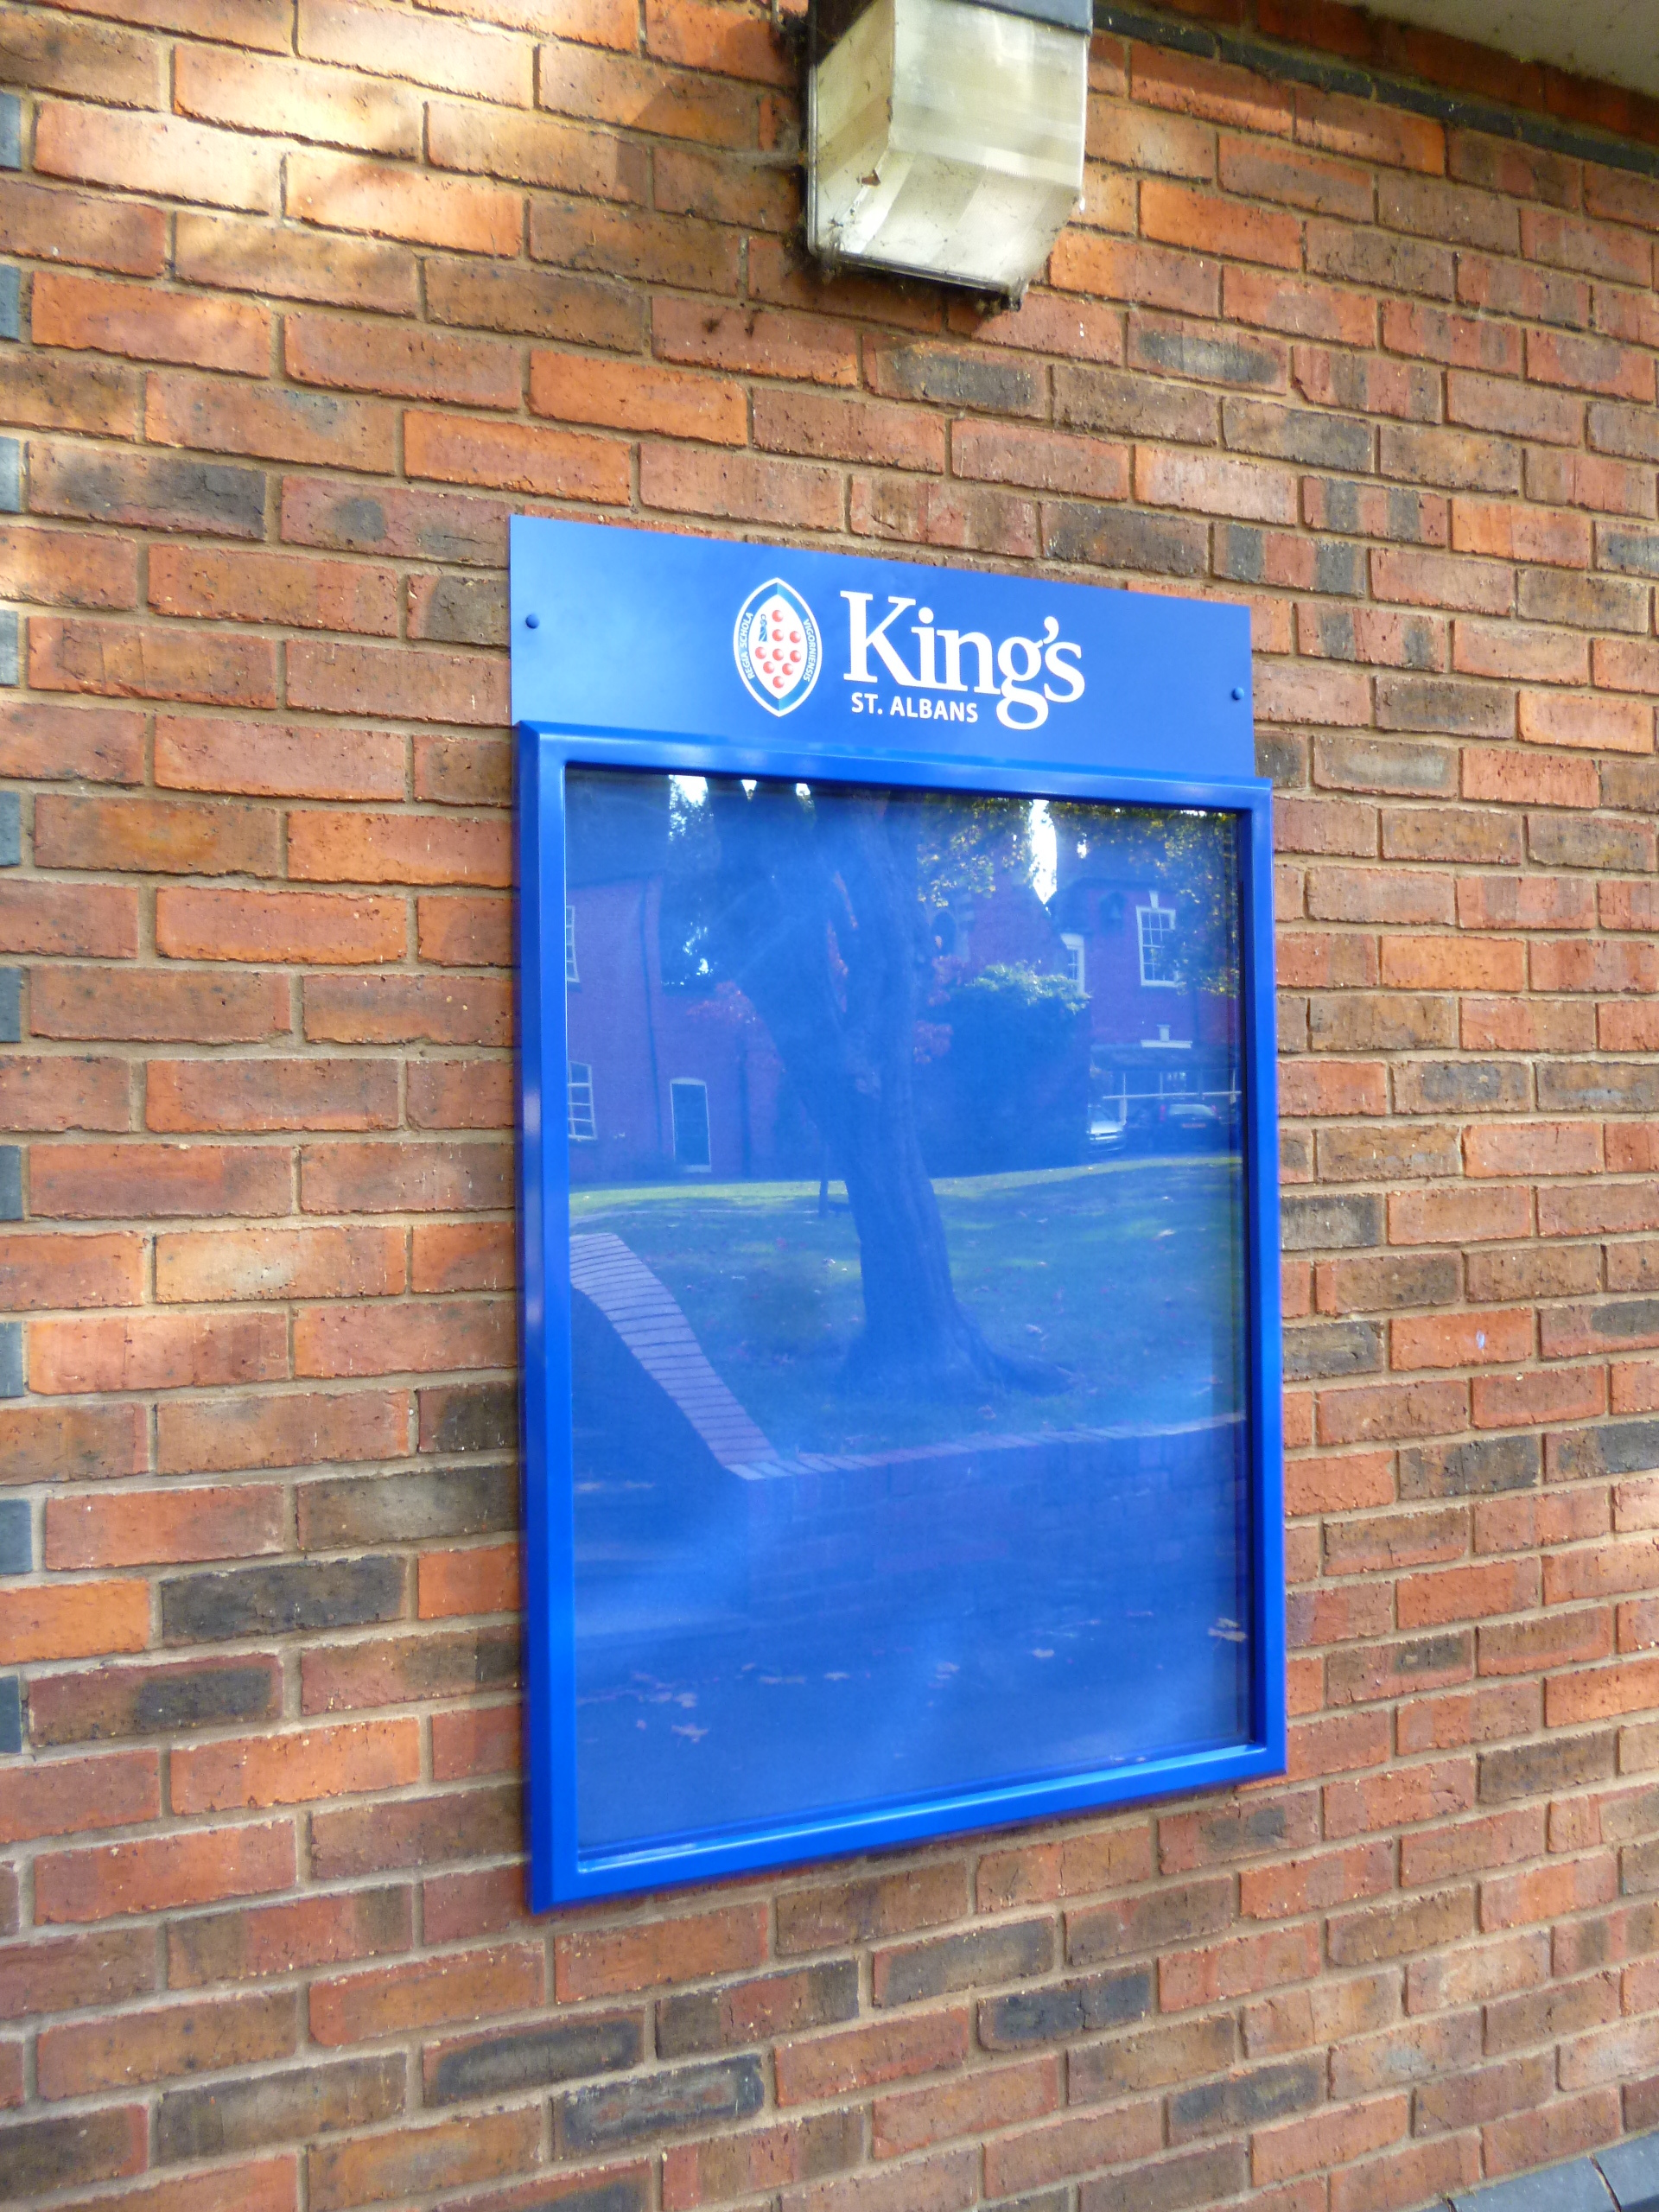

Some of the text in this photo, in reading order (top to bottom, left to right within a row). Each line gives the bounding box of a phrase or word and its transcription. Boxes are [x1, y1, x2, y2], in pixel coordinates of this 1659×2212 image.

[739, 612, 755, 680] REGIA SCHOLA
[802, 618, 817, 682] VIGORNIENSIS
[840, 590, 1085, 730] King's
[851, 692, 979, 723] ST. ALBANS
